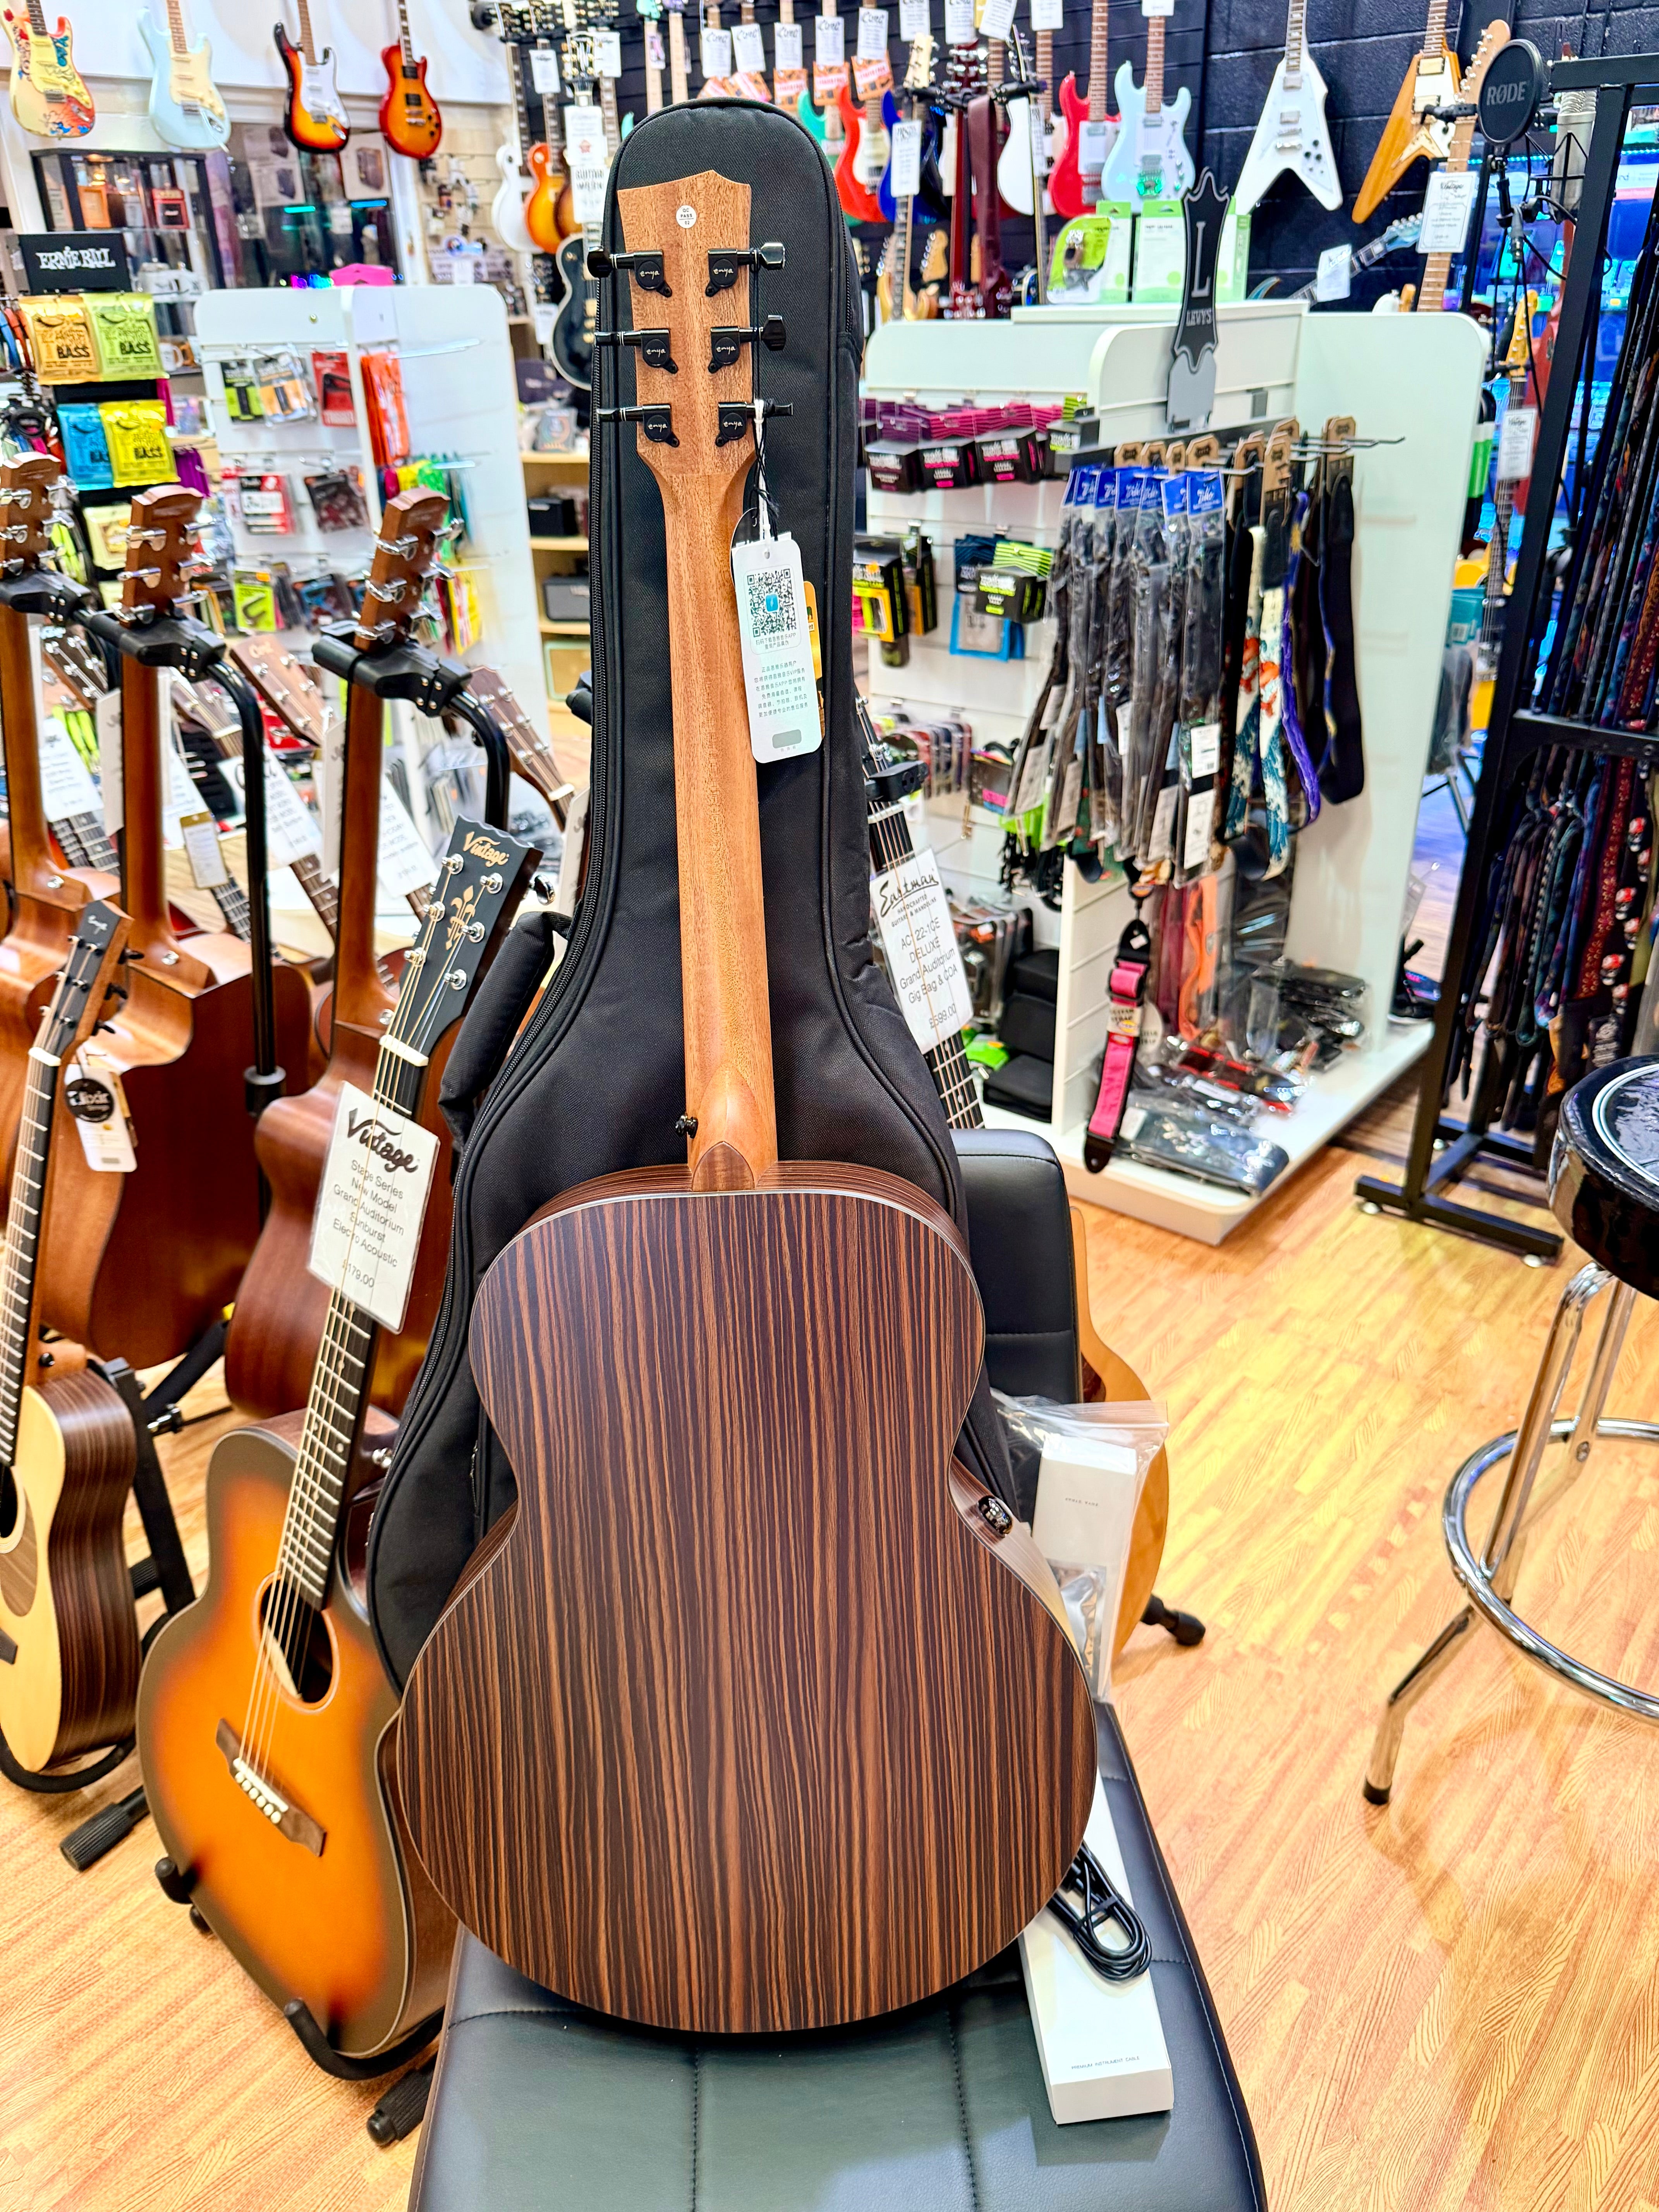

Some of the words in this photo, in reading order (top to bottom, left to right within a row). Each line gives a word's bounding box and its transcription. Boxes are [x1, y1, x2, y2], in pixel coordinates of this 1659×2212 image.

[1487, 81, 1527, 105] RØDE
[36, 246, 81, 269] ERNIE
[79, 248, 116, 268] BALL
[1191, 221, 1211, 297] L
[640, 270, 660, 280] enya
[713, 268, 734, 277] enya
[57, 345, 90, 359] BASS
[120, 341, 151, 355] BASS
[646, 349, 666, 357] enya
[716, 346, 736, 355] enya
[648, 424, 667, 432] enya
[723, 421, 743, 430] enya
[463, 831, 509, 867] Vintage
[879, 874, 939, 918] Eastman
[901, 917, 941, 950] AC22-1CE
[909, 936, 941, 963] DELUXE
[900, 969, 921, 989] Grand
[922, 947, 955, 976] Auditorium
[908, 990, 921, 1004] Gig
[921, 981, 937, 996] Bag
[938, 974, 943, 982] &
[944, 963, 958, 981] COA
[929, 1003, 957, 1029] £599.00
[347, 1108, 419, 1173] Vintage
[351, 1159, 373, 1182] Stage
[375, 1175, 404, 1199] Series
[351, 1177, 368, 1195] New
[370, 1191, 397, 1213] Model
[333, 1184, 359, 1206] Grand
[360, 1204, 404, 1236] Auditorium
[349, 1212, 386, 1242] Sunburst
[333, 1219, 360, 1244] Elecro
[361, 1237, 398, 1267] Acoustic
